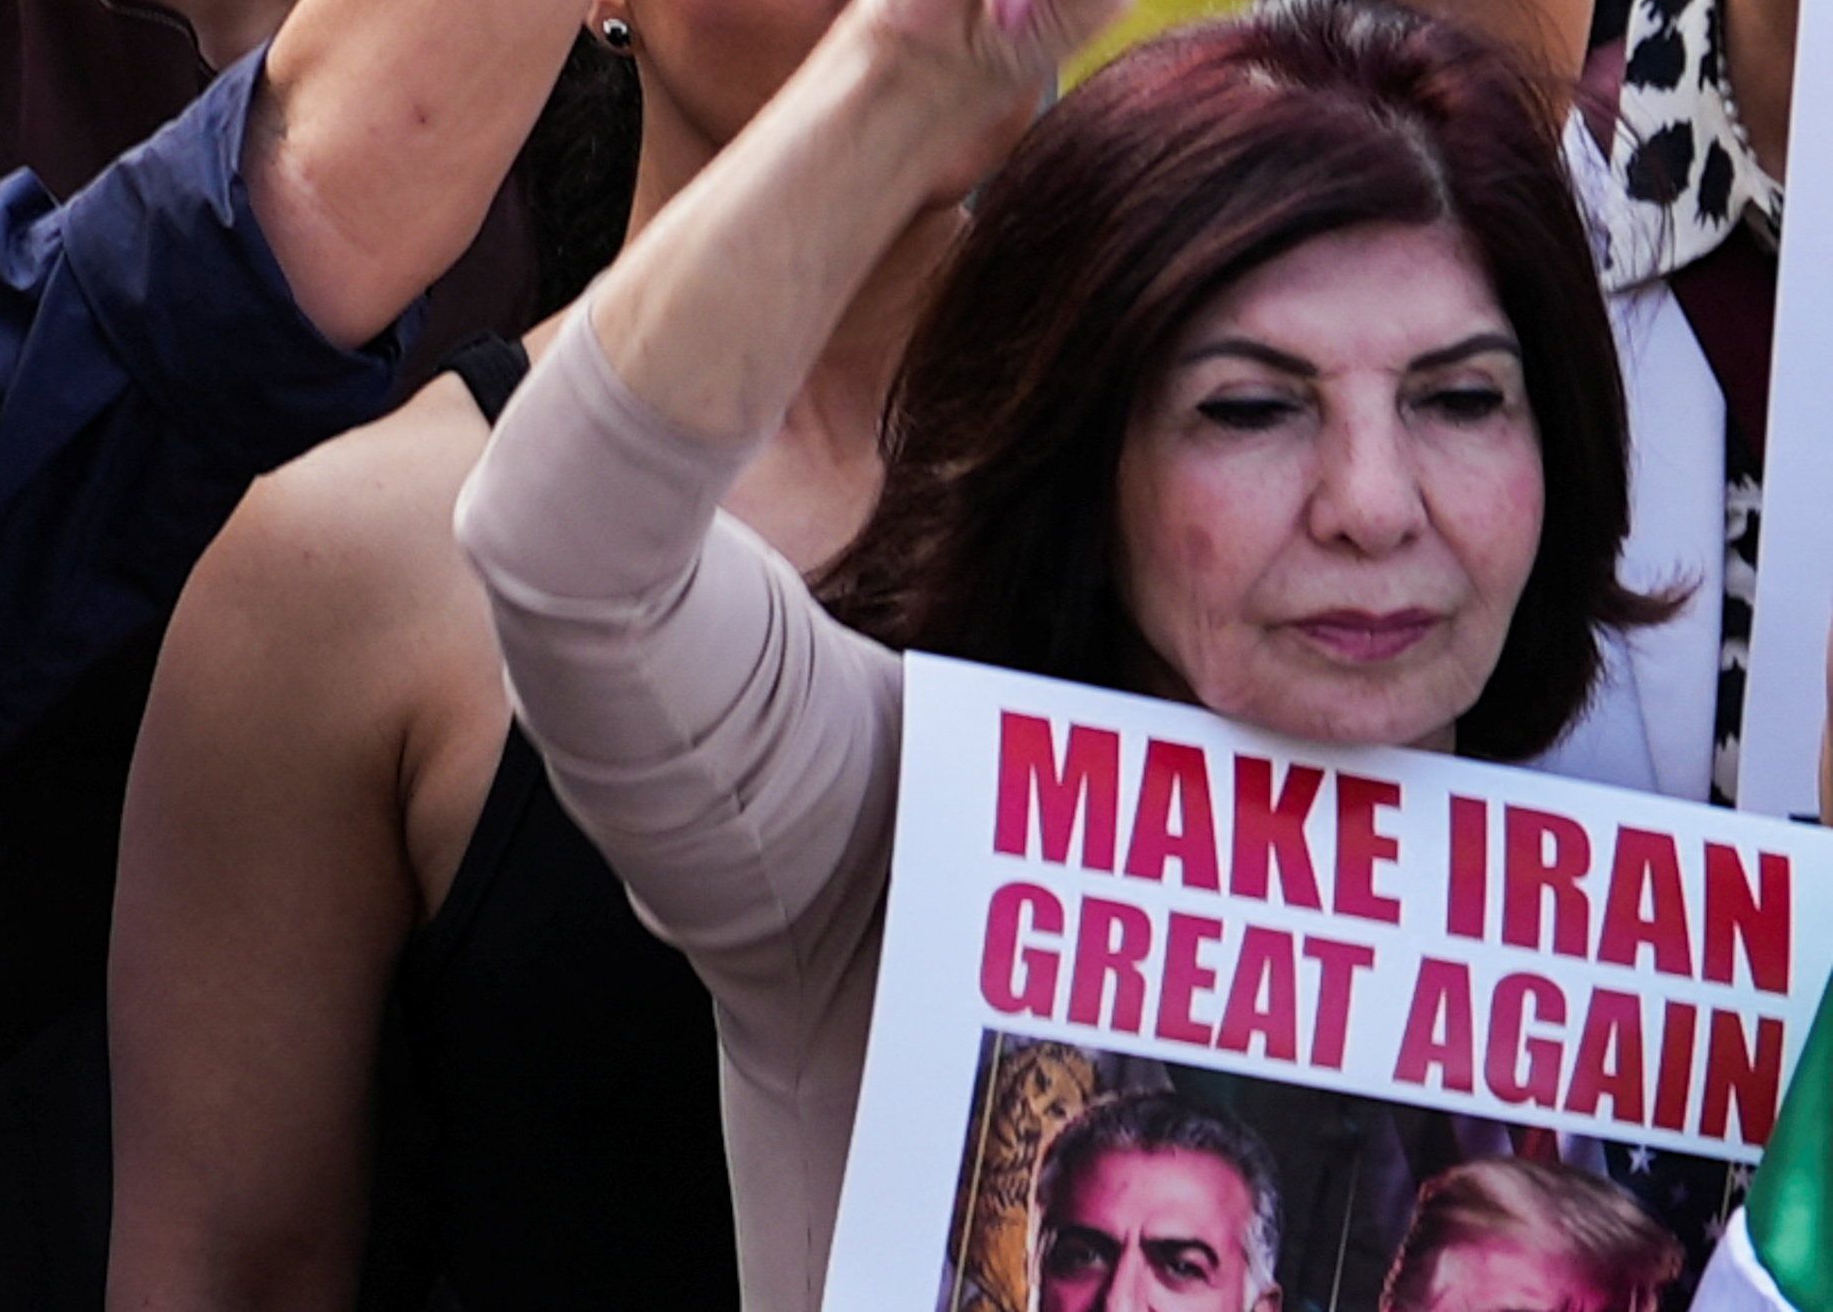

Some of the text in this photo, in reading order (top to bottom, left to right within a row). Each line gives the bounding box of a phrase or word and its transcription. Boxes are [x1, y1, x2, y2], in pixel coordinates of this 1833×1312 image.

[992, 708, 1792, 998] MAKE IRAN
[979, 880, 1785, 1147] GREAT AGAIN
